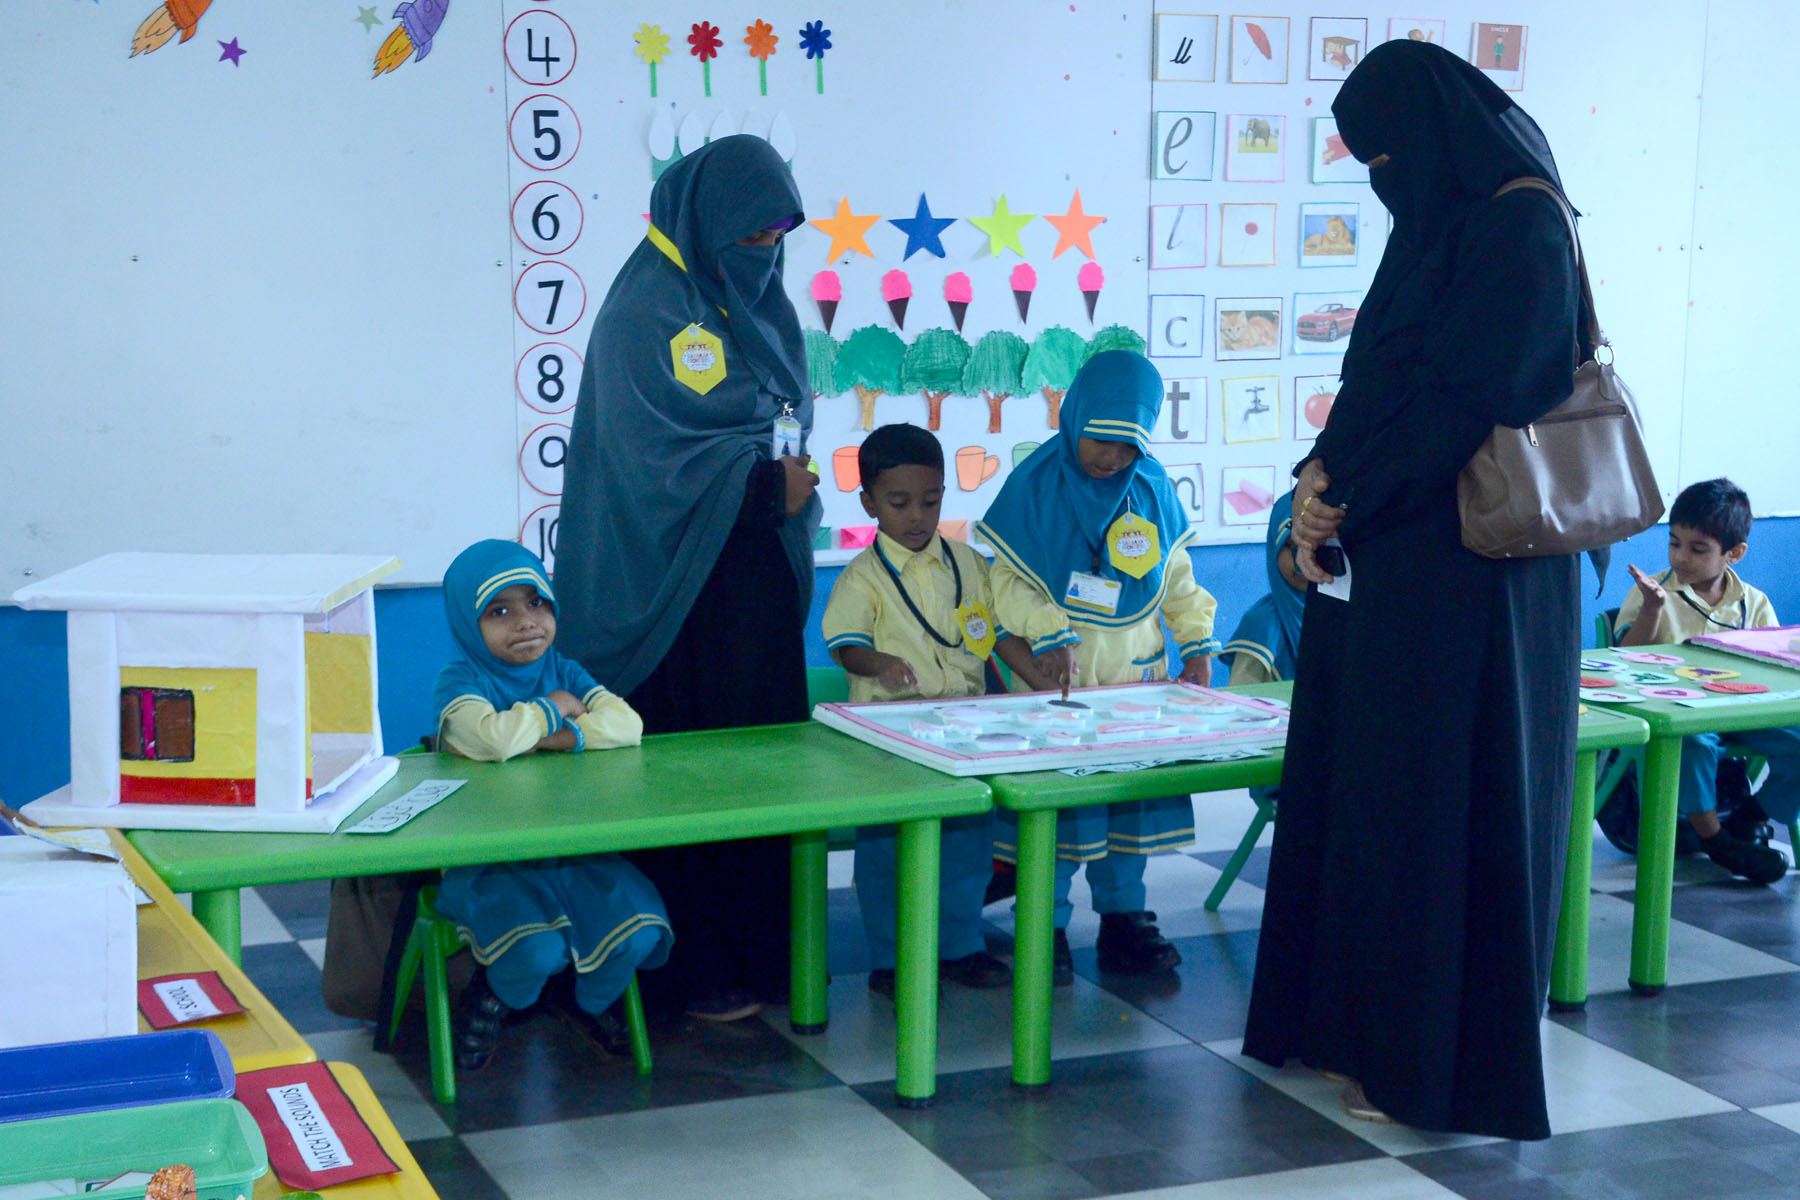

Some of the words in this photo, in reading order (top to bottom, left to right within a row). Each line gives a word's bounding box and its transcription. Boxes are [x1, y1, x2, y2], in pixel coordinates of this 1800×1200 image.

[527, 29, 560, 77] 4
[1170, 37, 1193, 65] u
[532, 110, 561, 161] 5
[1163, 117, 1193, 175] e
[532, 194, 561, 241] 6
[538, 280, 564, 324] 7
[1165, 316, 1188, 348] c
[538, 354, 564, 403] 8
[1166, 381, 1190, 440] t
[280, 1088, 314, 1120] SOUNDS
[299, 1122, 324, 1137] THE
[308, 1138, 343, 1168] MATCH
